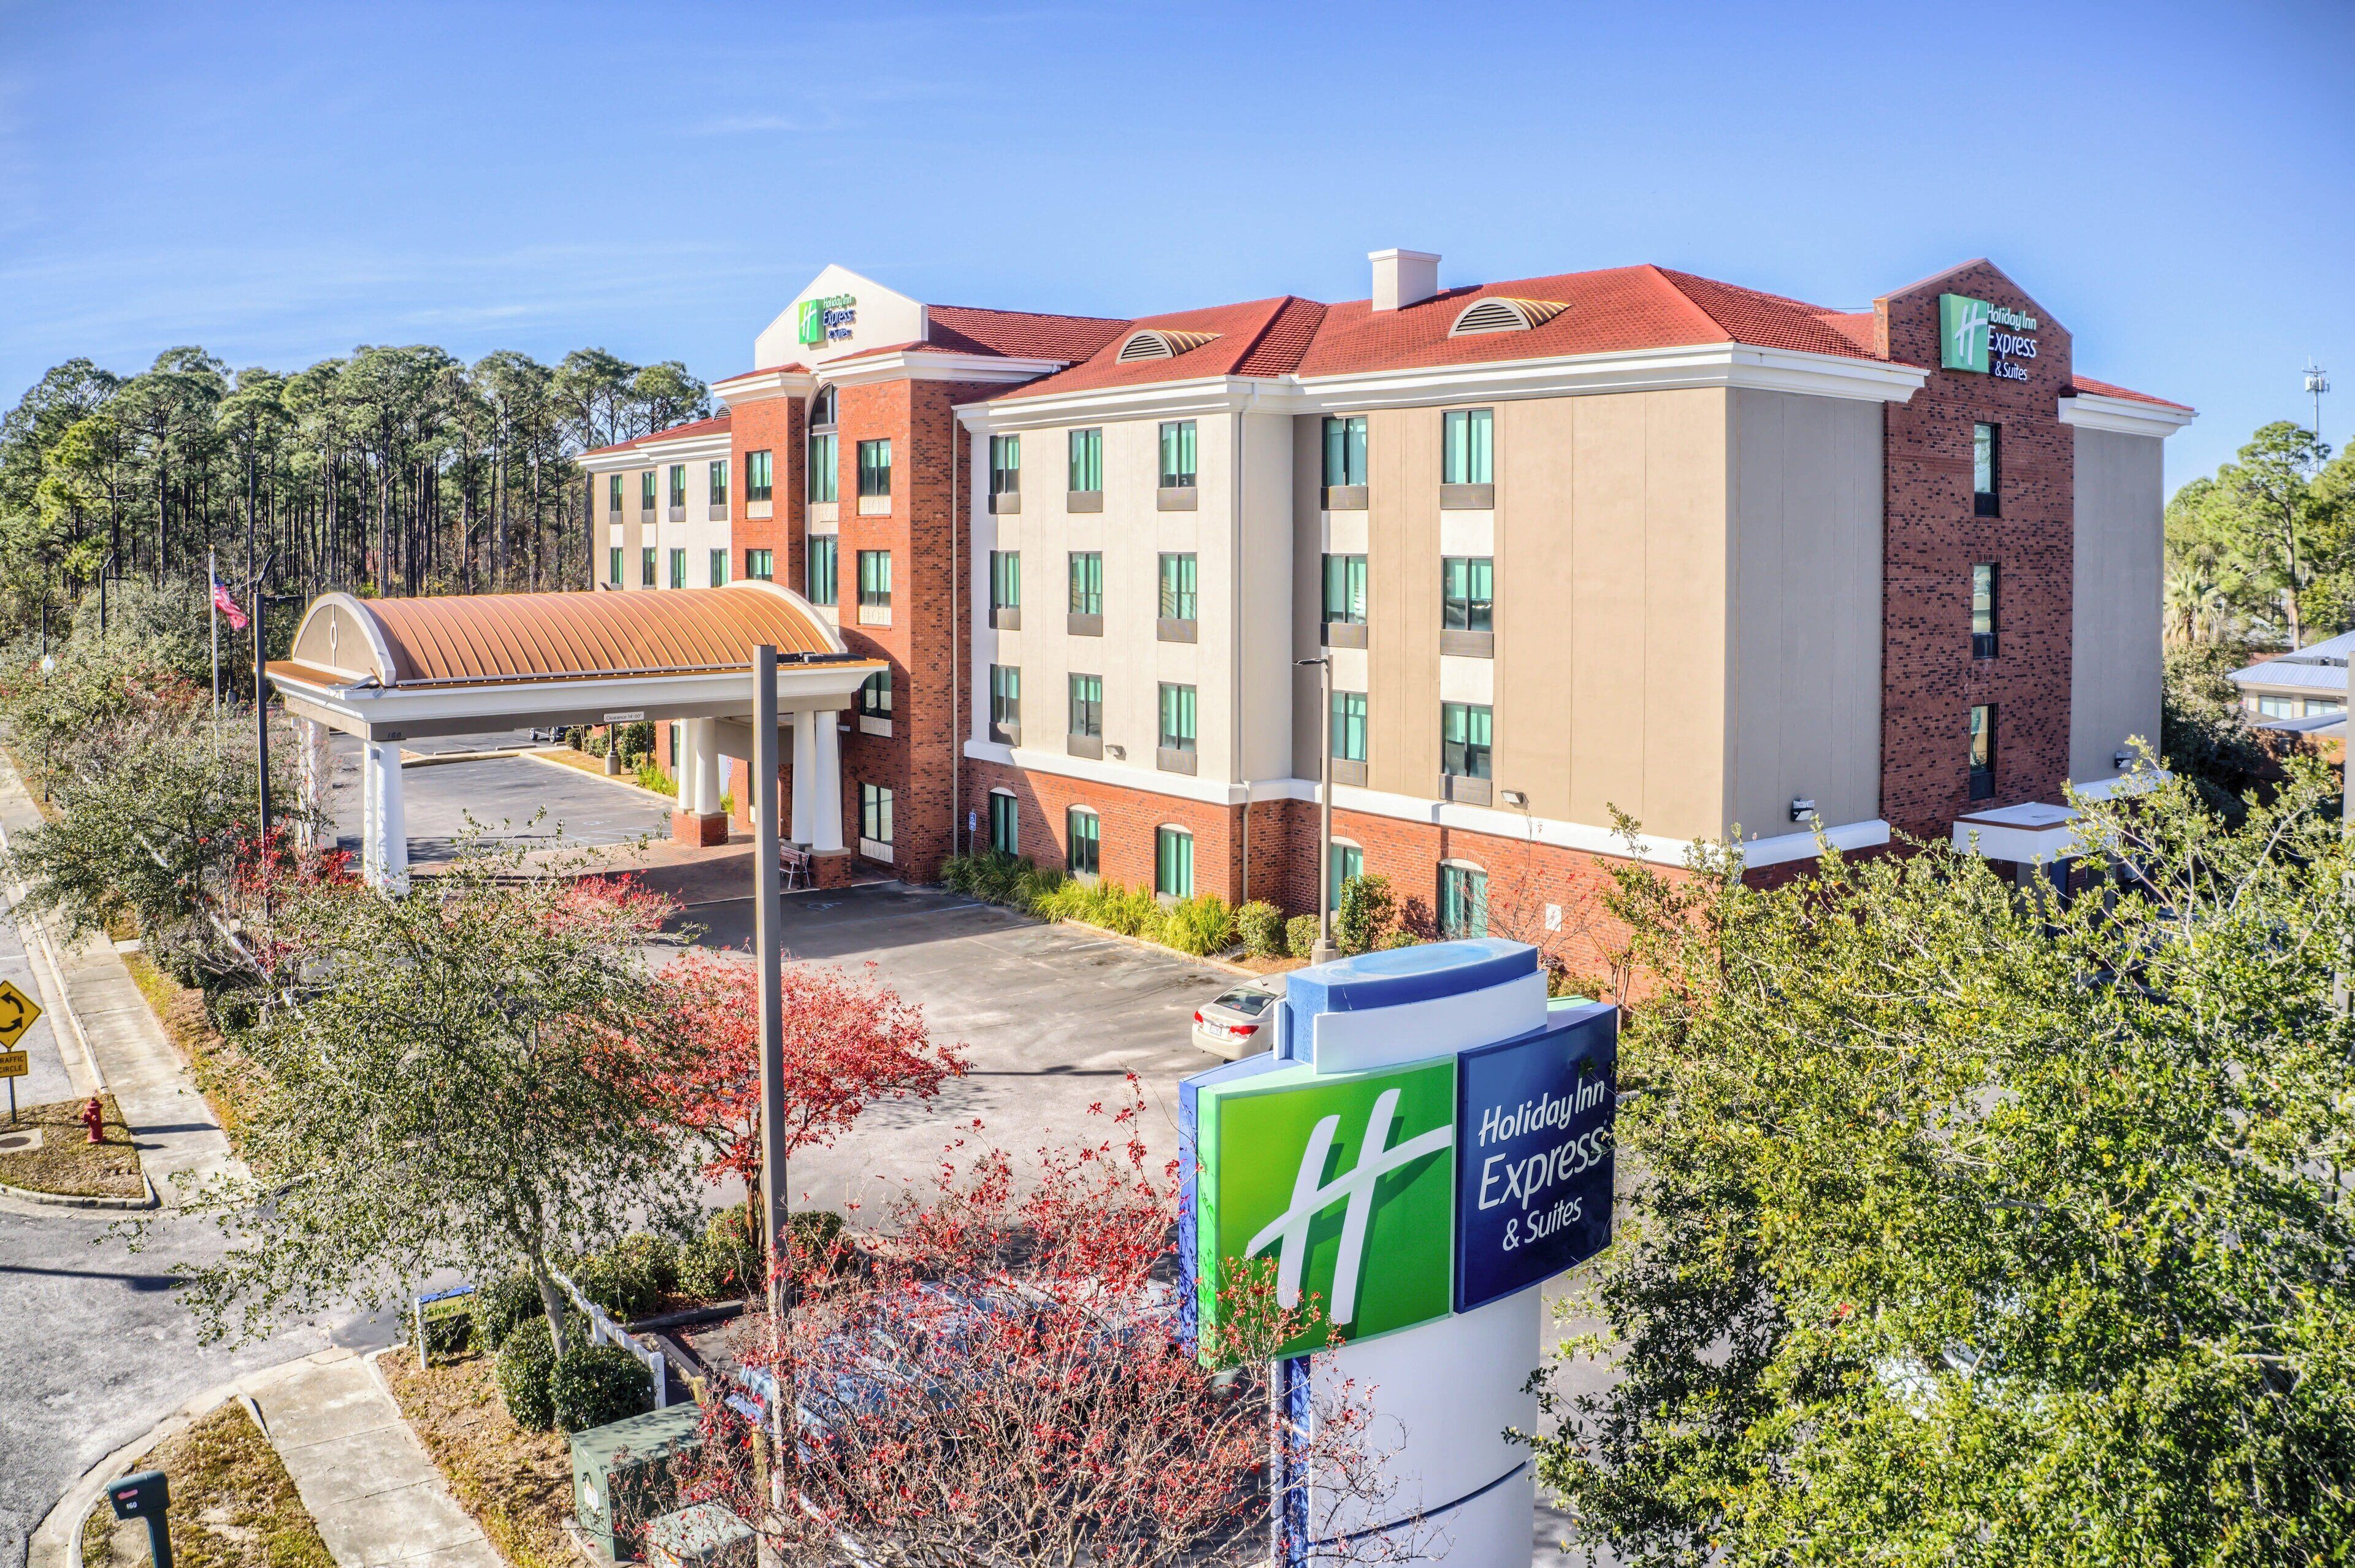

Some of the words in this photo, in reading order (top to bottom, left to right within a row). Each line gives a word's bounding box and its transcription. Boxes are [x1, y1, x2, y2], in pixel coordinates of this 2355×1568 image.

[824, 296, 843, 308] Holiday
[843, 293, 852, 304] Inn
[823, 310, 851, 327] Express
[1987, 303, 2021, 331] Holiday
[2022, 311, 2037, 330] Inn
[833, 329, 848, 338] Suites
[1988, 325, 2037, 359] Express
[1995, 361, 2002, 377] &
[2003, 362, 2028, 380] Suites
[1478, 1093, 1573, 1147] Holiday
[1575, 1078, 1604, 1114] Inn
[1479, 1126, 1604, 1210] Express
[1503, 1218, 1519, 1251] &
[1525, 1197, 1582, 1243] Suites
[126, 1501, 137, 1510] 160
